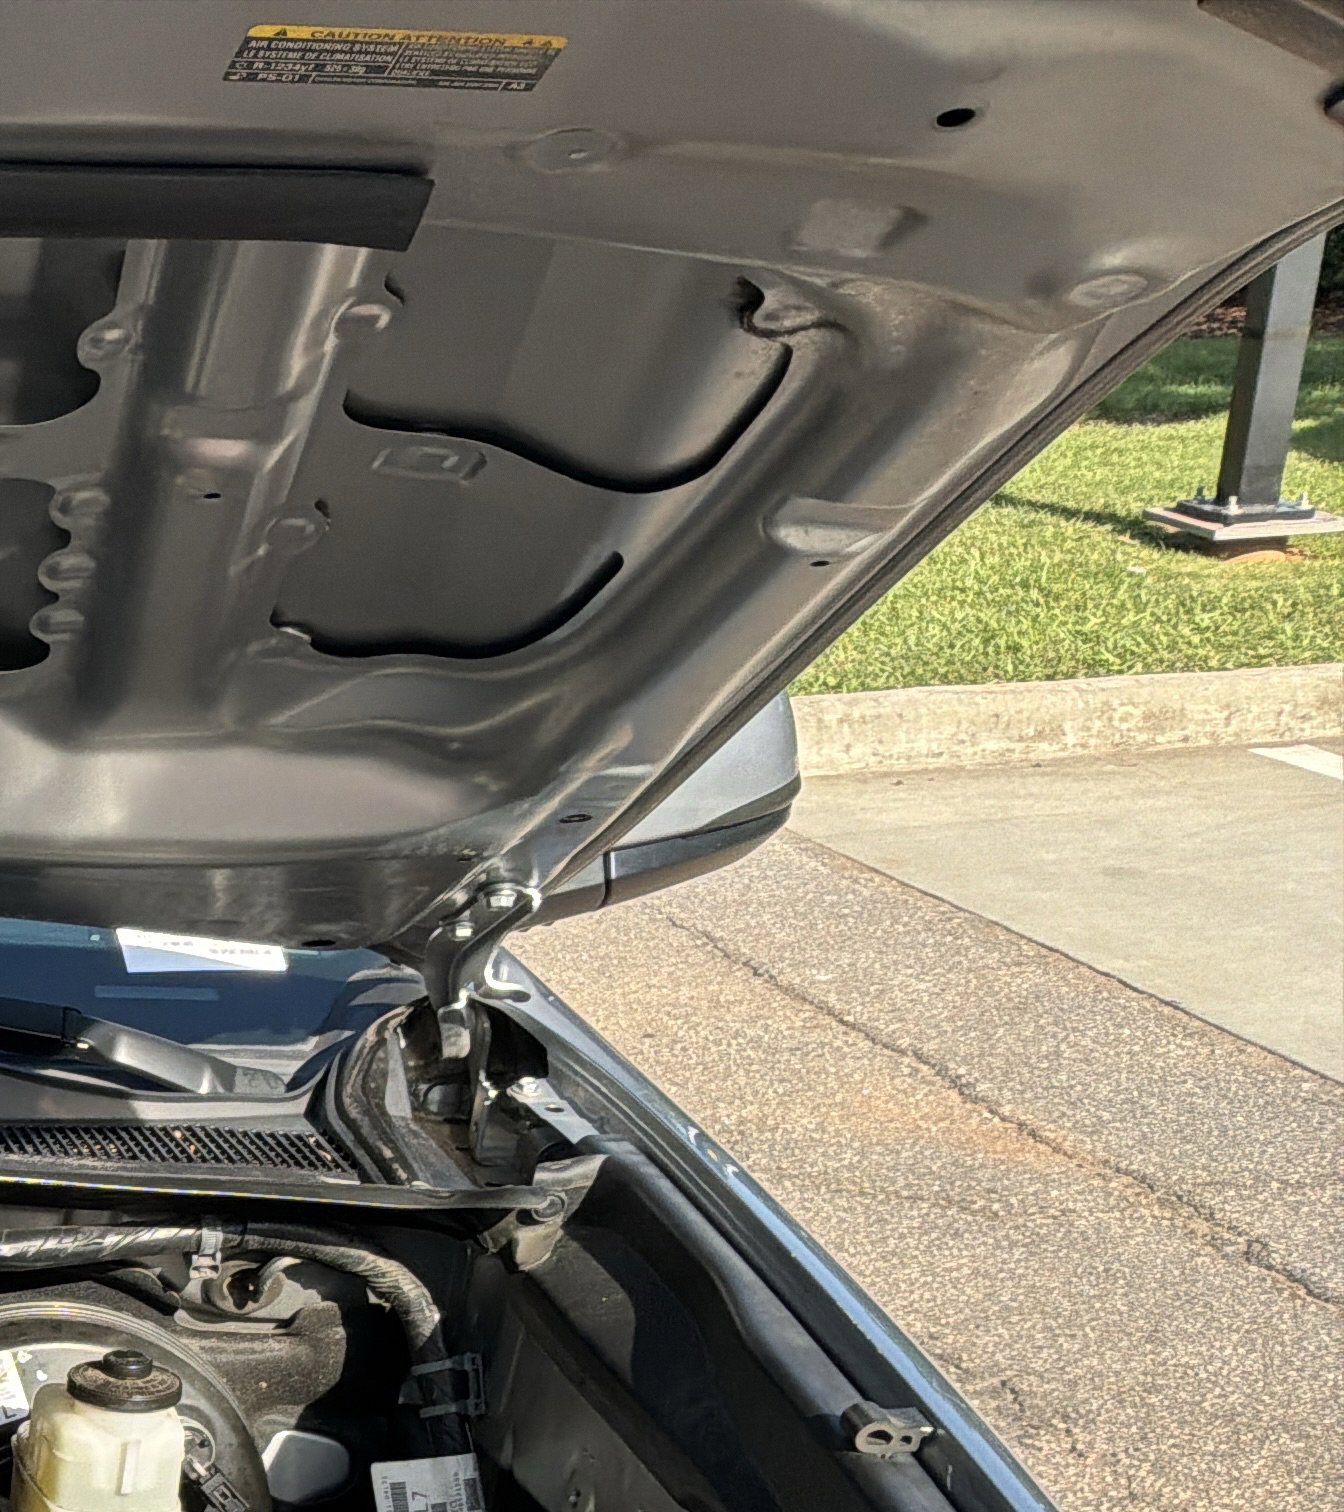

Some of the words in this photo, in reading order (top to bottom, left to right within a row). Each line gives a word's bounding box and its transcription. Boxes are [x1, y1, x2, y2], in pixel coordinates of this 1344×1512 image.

[310, 30, 394, 41] CAUTION
[399, 33, 507, 46] ATTENTION
[248, 40, 268, 48] AIR
[270, 41, 351, 51] CONDITIONING
[353, 43, 400, 53] SYSTEM
[304, 52, 317, 60] DE
[319, 52, 393, 63] CLIMATISATION
[412, 1491, 429, 1512] L7
